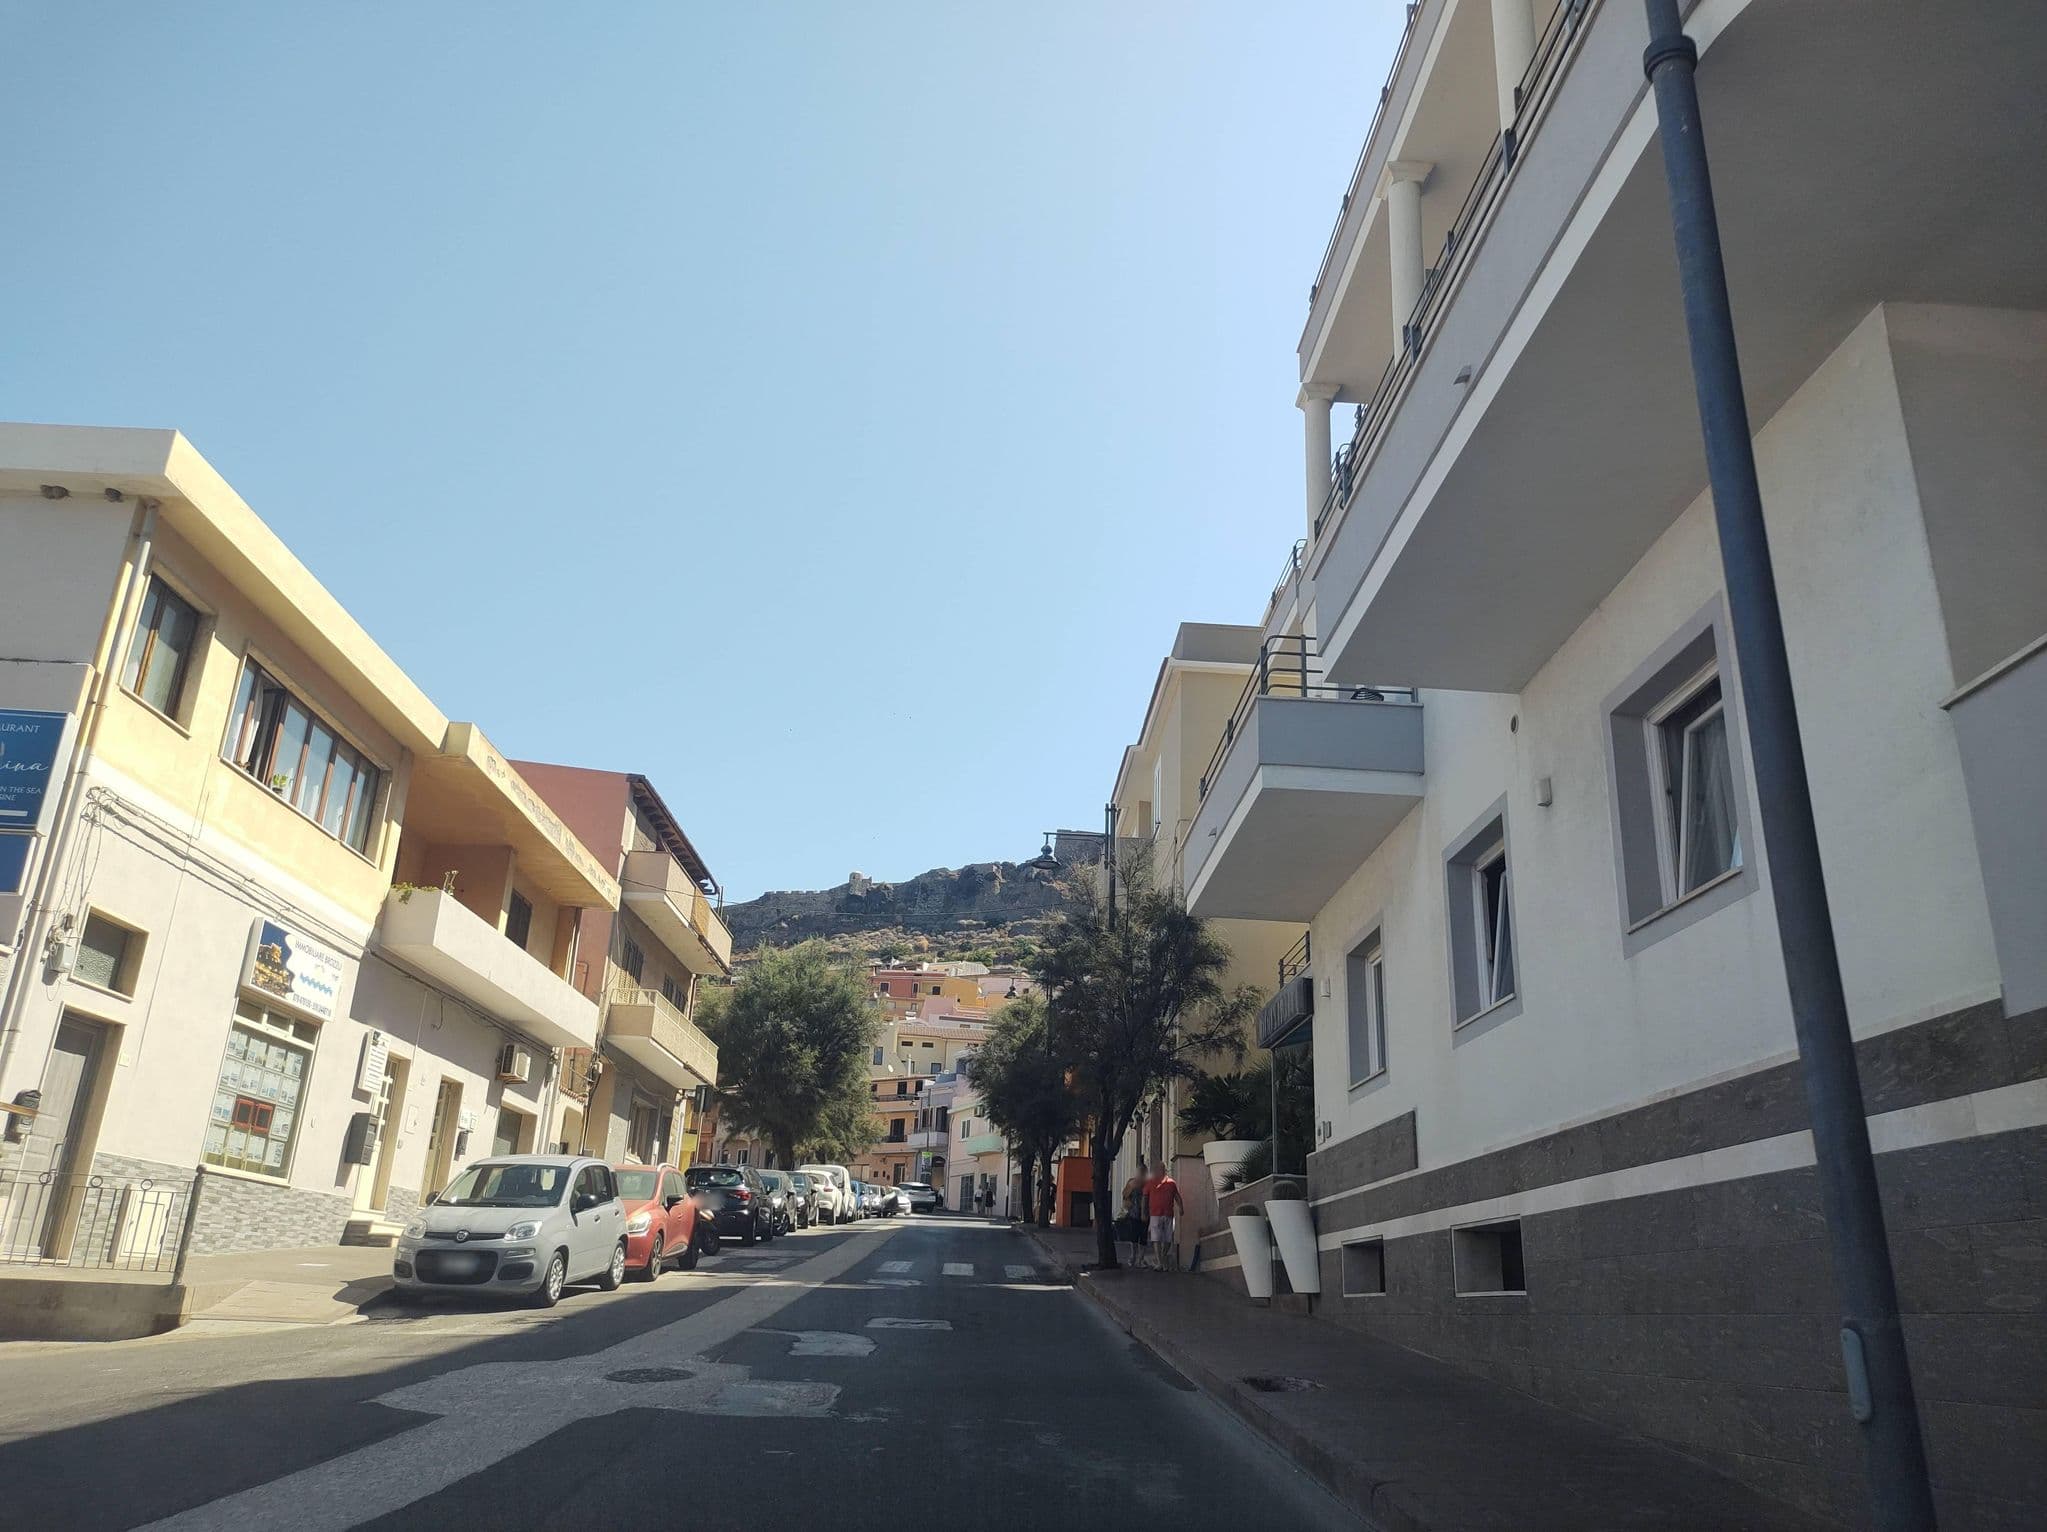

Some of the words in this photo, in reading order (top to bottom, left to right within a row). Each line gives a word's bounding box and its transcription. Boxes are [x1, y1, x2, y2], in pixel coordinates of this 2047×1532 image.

[0, 723, 40, 733] URANT
[0, 760, 48, 771] ina
[9, 785, 25, 794] THE
[26, 786, 41, 795] SEA
